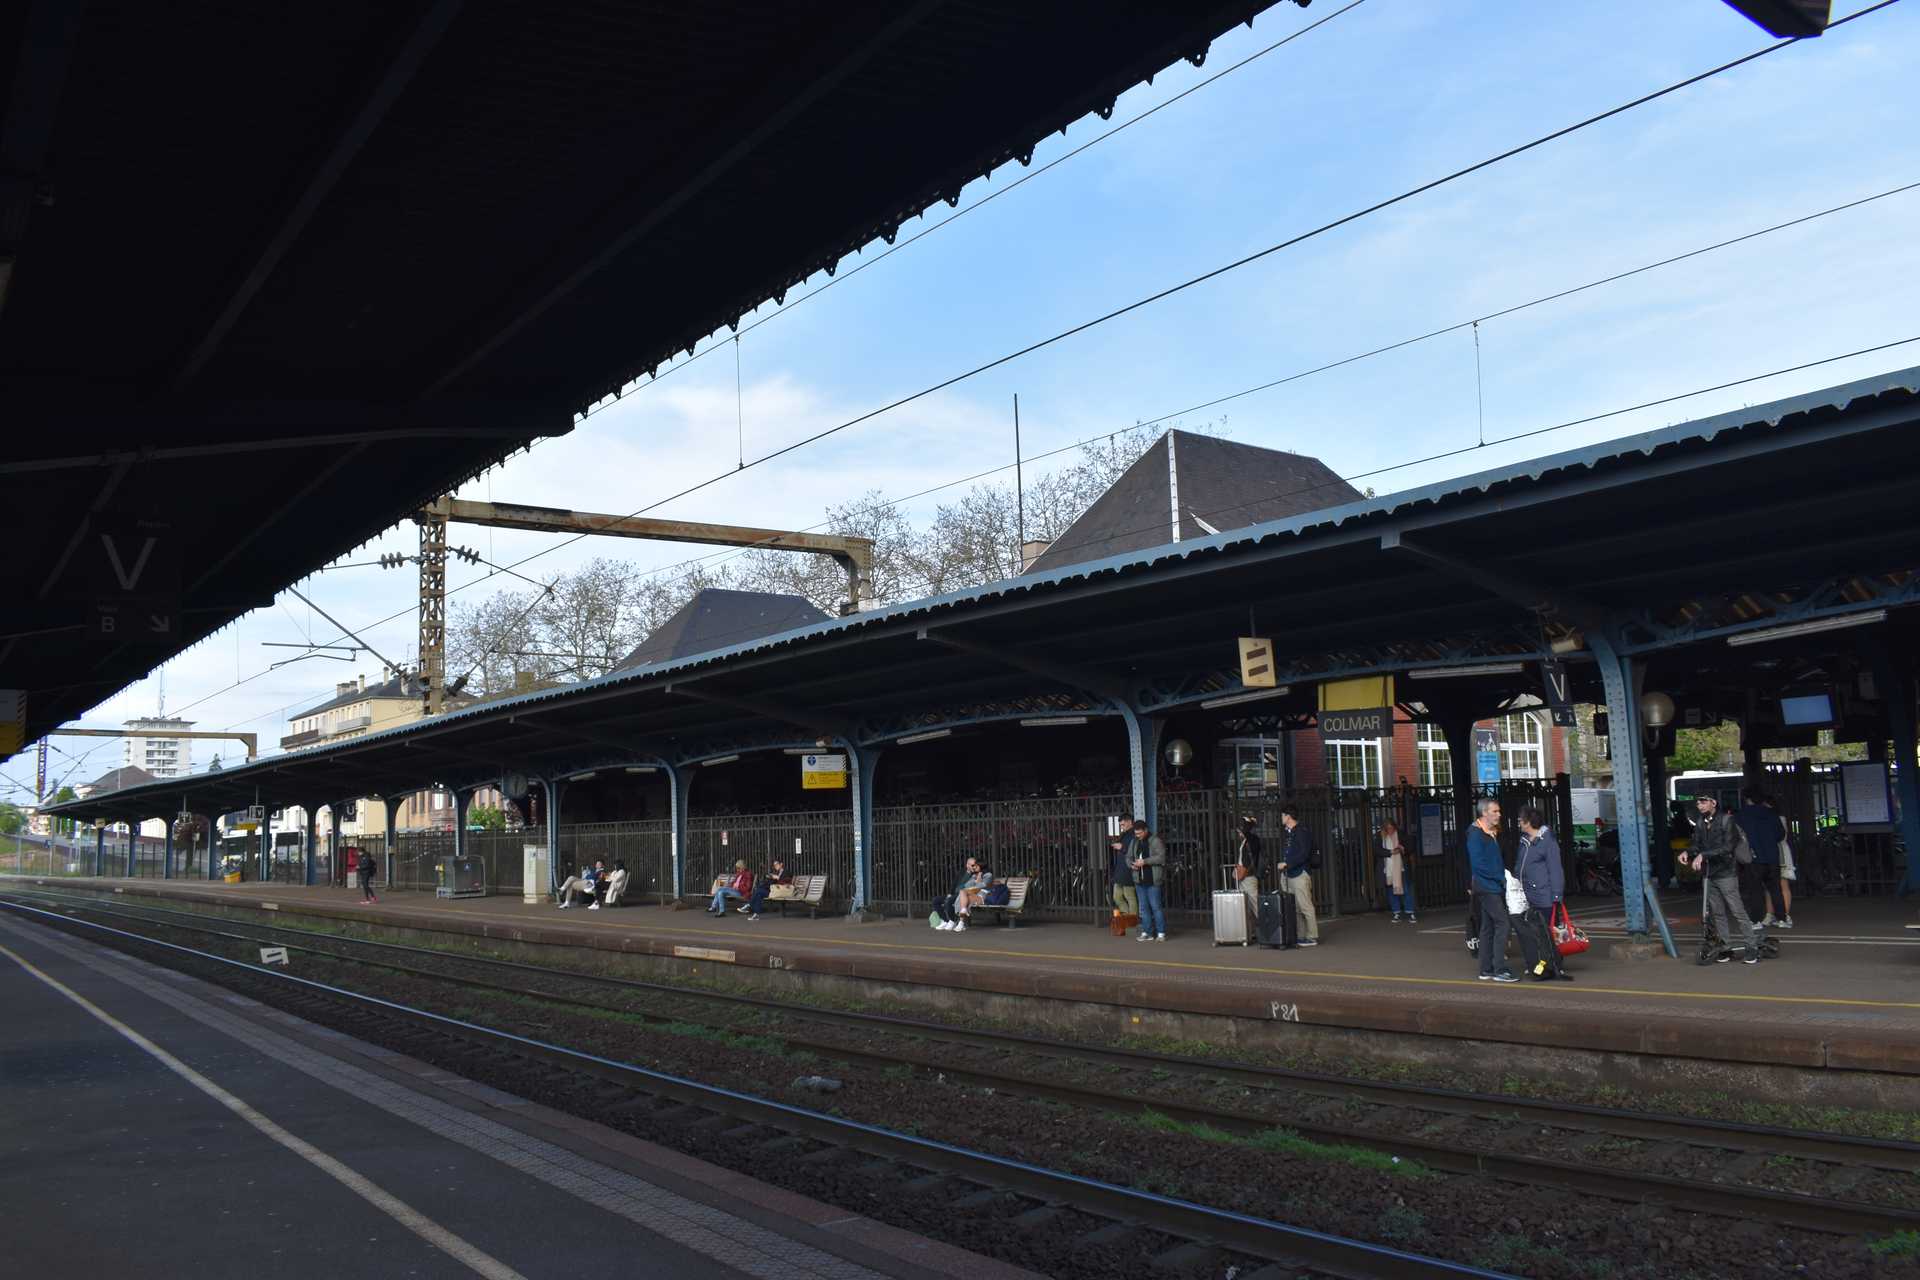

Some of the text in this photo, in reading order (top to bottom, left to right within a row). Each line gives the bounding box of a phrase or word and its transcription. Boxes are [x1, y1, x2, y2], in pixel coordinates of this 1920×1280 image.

[99, 533, 158, 591] V
[101, 616, 116, 633] B
[1549, 673, 1565, 702] V
[1324, 716, 1380, 733] COLMAR
